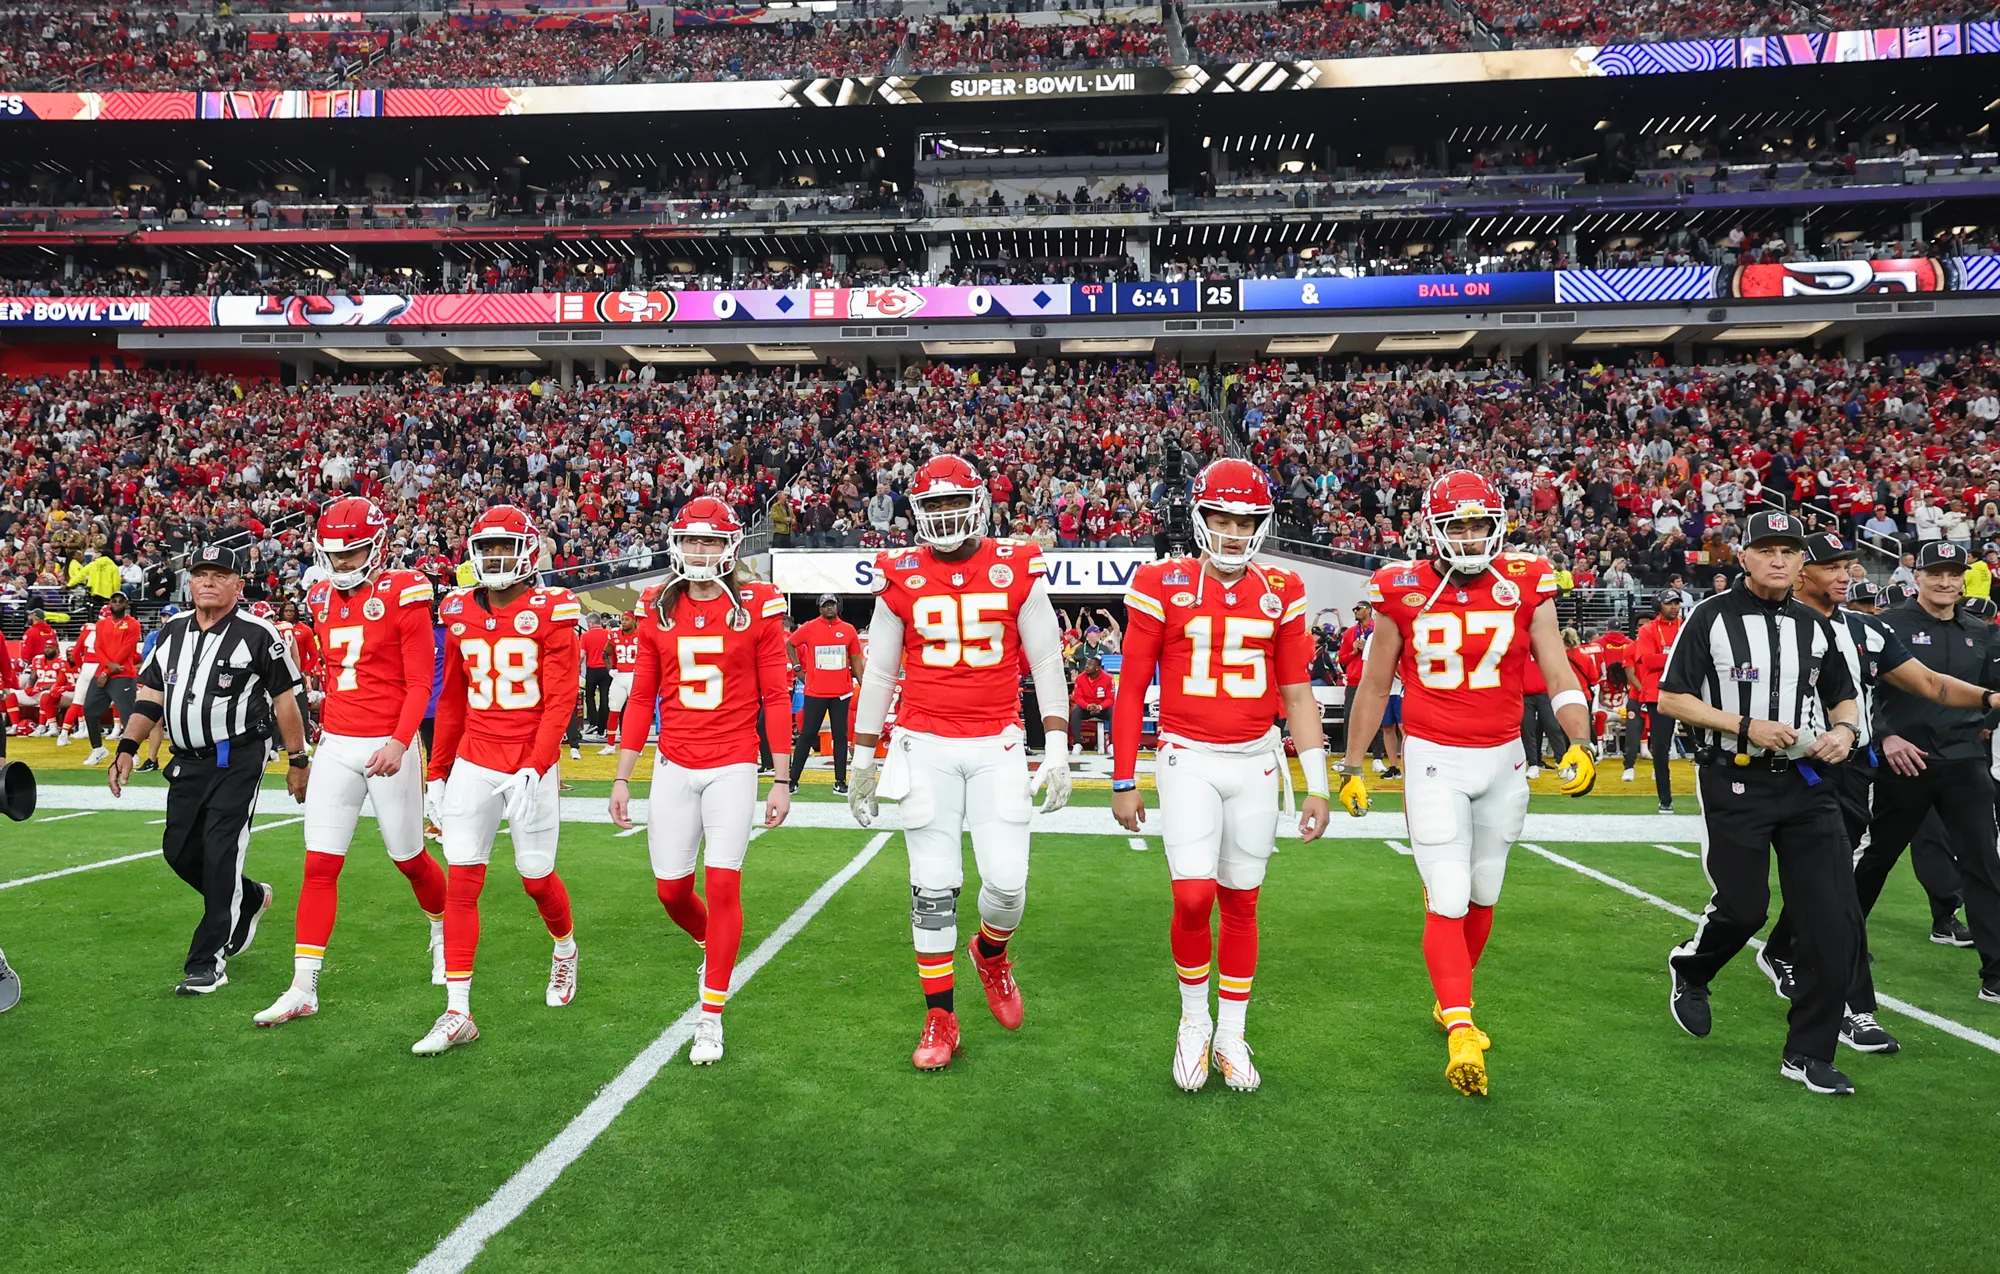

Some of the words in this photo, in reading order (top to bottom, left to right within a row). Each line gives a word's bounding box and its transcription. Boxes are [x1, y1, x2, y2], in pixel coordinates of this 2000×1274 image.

[950, 78, 1016, 97] SUPER
[1025, 75, 1088, 94] BOWL
[1096, 73, 1135, 92] LVIII
[968, 288, 992, 315] 0
[1081, 285, 1103, 295] QTR
[1132, 288, 1179, 307] 6:41
[1206, 287, 1233, 305] 25
[1301, 283, 1320, 304] &
[1418, 284, 1458, 297] BALL
[1464, 282, 1490, 296] ON
[34, 302, 101, 320] BOWL
[109, 302, 149, 320] LVIII
[713, 292, 737, 319] 0
[1087, 294, 1096, 312] 1
[912, 592, 1009, 668] 95
[329, 625, 364, 691] 7
[615, 645, 638, 663] 20
[1183, 616, 1275, 698] 15
[1413, 611, 1515, 690] 87
[460, 637, 541, 710] 38
[677, 636, 724, 710] 5
